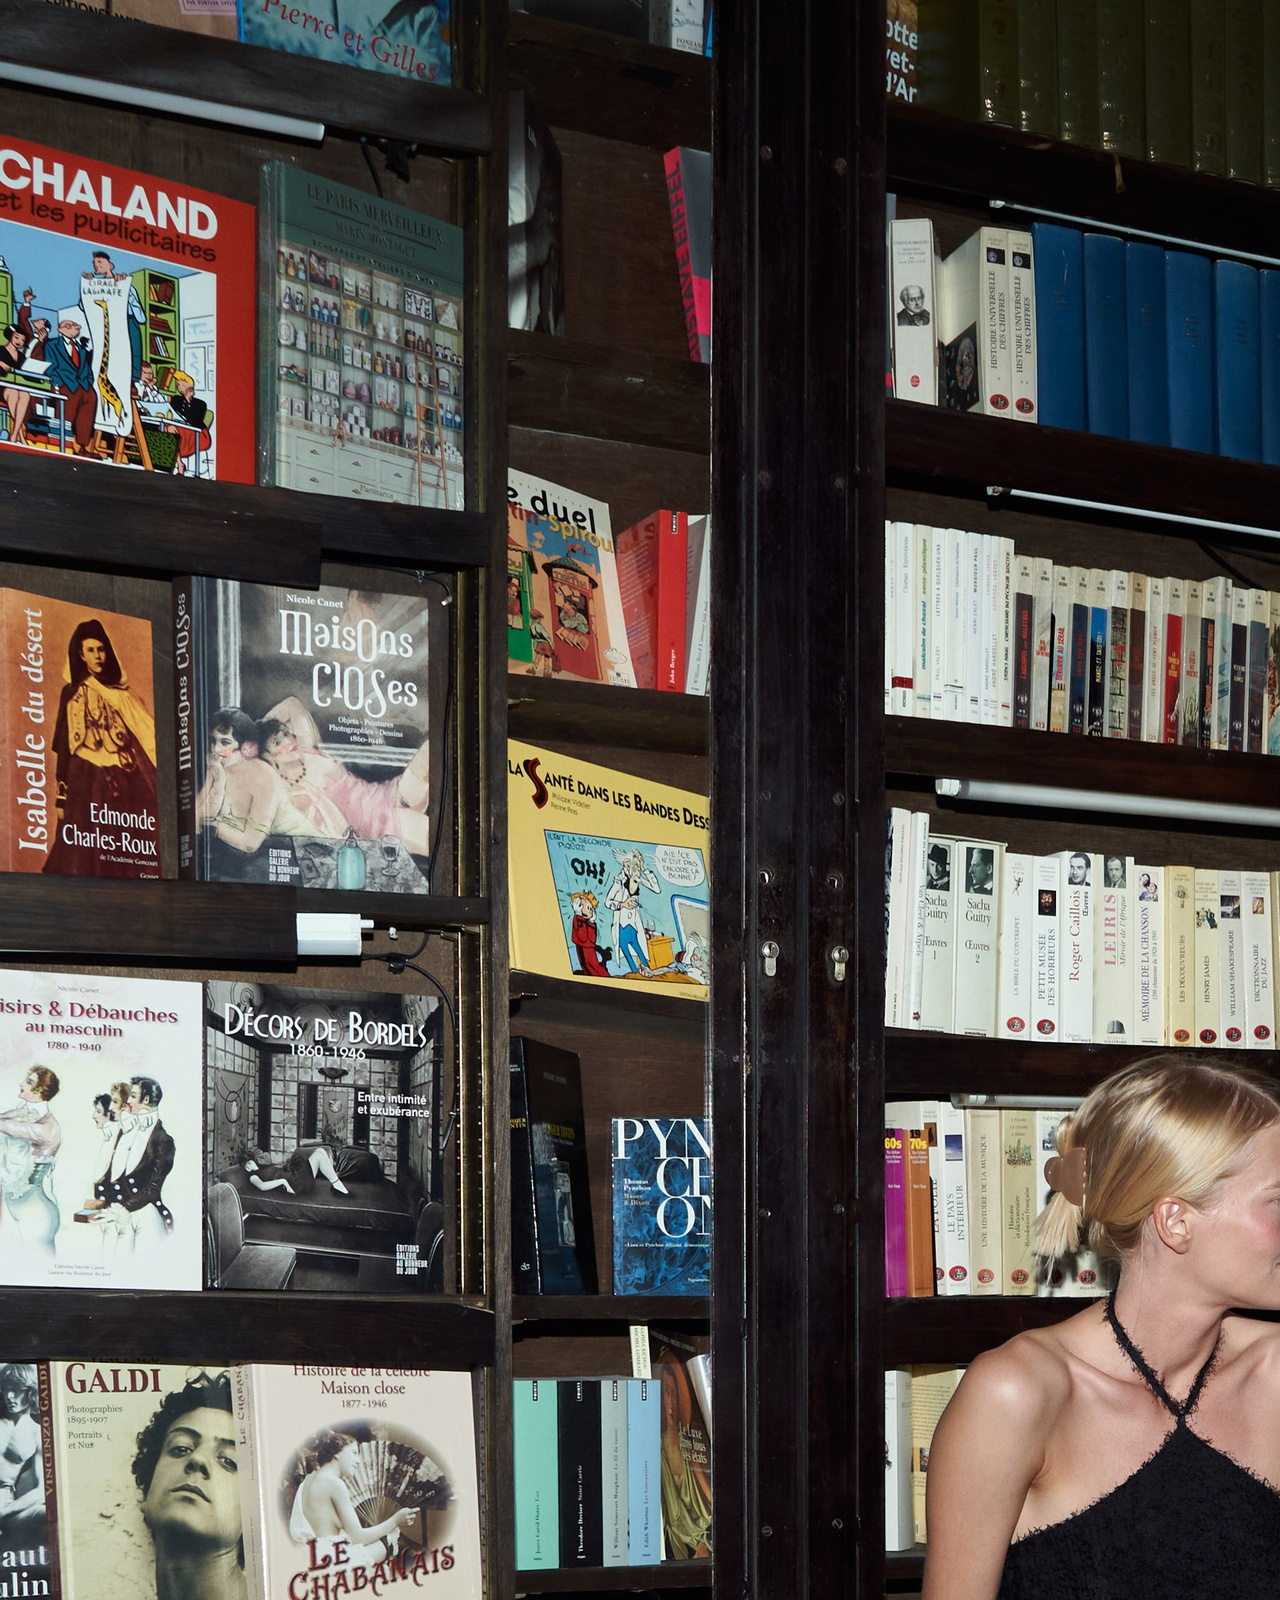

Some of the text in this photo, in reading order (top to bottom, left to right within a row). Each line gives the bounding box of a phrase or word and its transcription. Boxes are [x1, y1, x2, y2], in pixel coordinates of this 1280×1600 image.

[262, 0, 437, 81] Pierre et Gilles
[0, 148, 218, 240] CHALAND
[666, 161, 689, 246] EIFFEL
[31, 196, 65, 223] les
[73, 210, 217, 263] publicitaires
[326, 191, 360, 213] PARIS
[364, 203, 444, 243] MERVEILLEUX
[989, 270, 998, 369] HISTOIRE UNIVERSELLE
[998, 292, 1007, 351] DES CHIFFRES
[1013, 275, 1024, 374] HISTOIRE UNIVERSELLE
[1024, 297, 1032, 355] DES CHIFFRES
[530, 490, 596, 535] duel
[920, 538, 928, 596] sens-plastique
[286, 594, 344, 609] Nicole Canet
[920, 627, 927, 637] de
[19, 608, 49, 854] Isabelle du désert
[508, 760, 524, 778] LA
[577, 782, 610, 803] DANS
[613, 791, 631, 808] LES
[634, 793, 680, 824] BANDES
[90, 802, 156, 831] Edmonde
[62, 824, 158, 857] Charles-Roux
[571, 858, 605, 885] OH!
[925, 894, 948, 908] Sacha
[967, 898, 991, 911] Sacha
[1082, 891, 1090, 917] Œuvres
[965, 911, 991, 928] Guitry
[1068, 890, 1083, 981] Roger Caillois
[1104, 894, 1117, 966] LEIRIS
[965, 940, 991, 951] Œuvres
[975, 953, 981, 964] 2
[1037, 934, 1046, 1000] PETIT MUSÉE
[1048, 928, 1056, 1006] DES HORREURS
[1140, 906, 1150, 1023] MÉMOIRE DE LA CHANSON
[1178, 935, 1186, 989] DÉCOUVREURS
[1253, 944, 1261, 1002] DICTIONNAIRE
[48, 1000, 63, 1017] &
[69, 1002, 179, 1024] Débauches
[224, 1002, 428, 1049] DÉCORS DE BORDELS
[25, 1022, 123, 1038] au masculin
[47, 1041, 102, 1052] 1780 1940
[289, 1043, 367, 1060] 1860-1946
[358, 1091, 427, 1106] Entre intimité
[358, 1106, 430, 1119] et exubérance
[885, 1137, 902, 1149] 60s
[910, 1137, 928, 1150] 70s
[980, 1134, 988, 1170] MUSIQUE
[981, 1171, 988, 1181] LA
[981, 1183, 988, 1193] DE
[947, 1193, 956, 1233] LE PAYS
[956, 1184, 965, 1241] INTÉRIEUR
[65, 1363, 161, 1394] GALDI
[321, 1381, 406, 1395] Maison close
[67, 1404, 123, 1415] Photographies
[67, 1415, 108, 1426] 1895-1907
[341, 1400, 387, 1409] 1877 1946
[38, 1363, 54, 1496] VINCENZO GALDI
[68, 1431, 103, 1440] Portraits
[68, 1441, 78, 1450] et
[306, 1537, 351, 1572] LE
